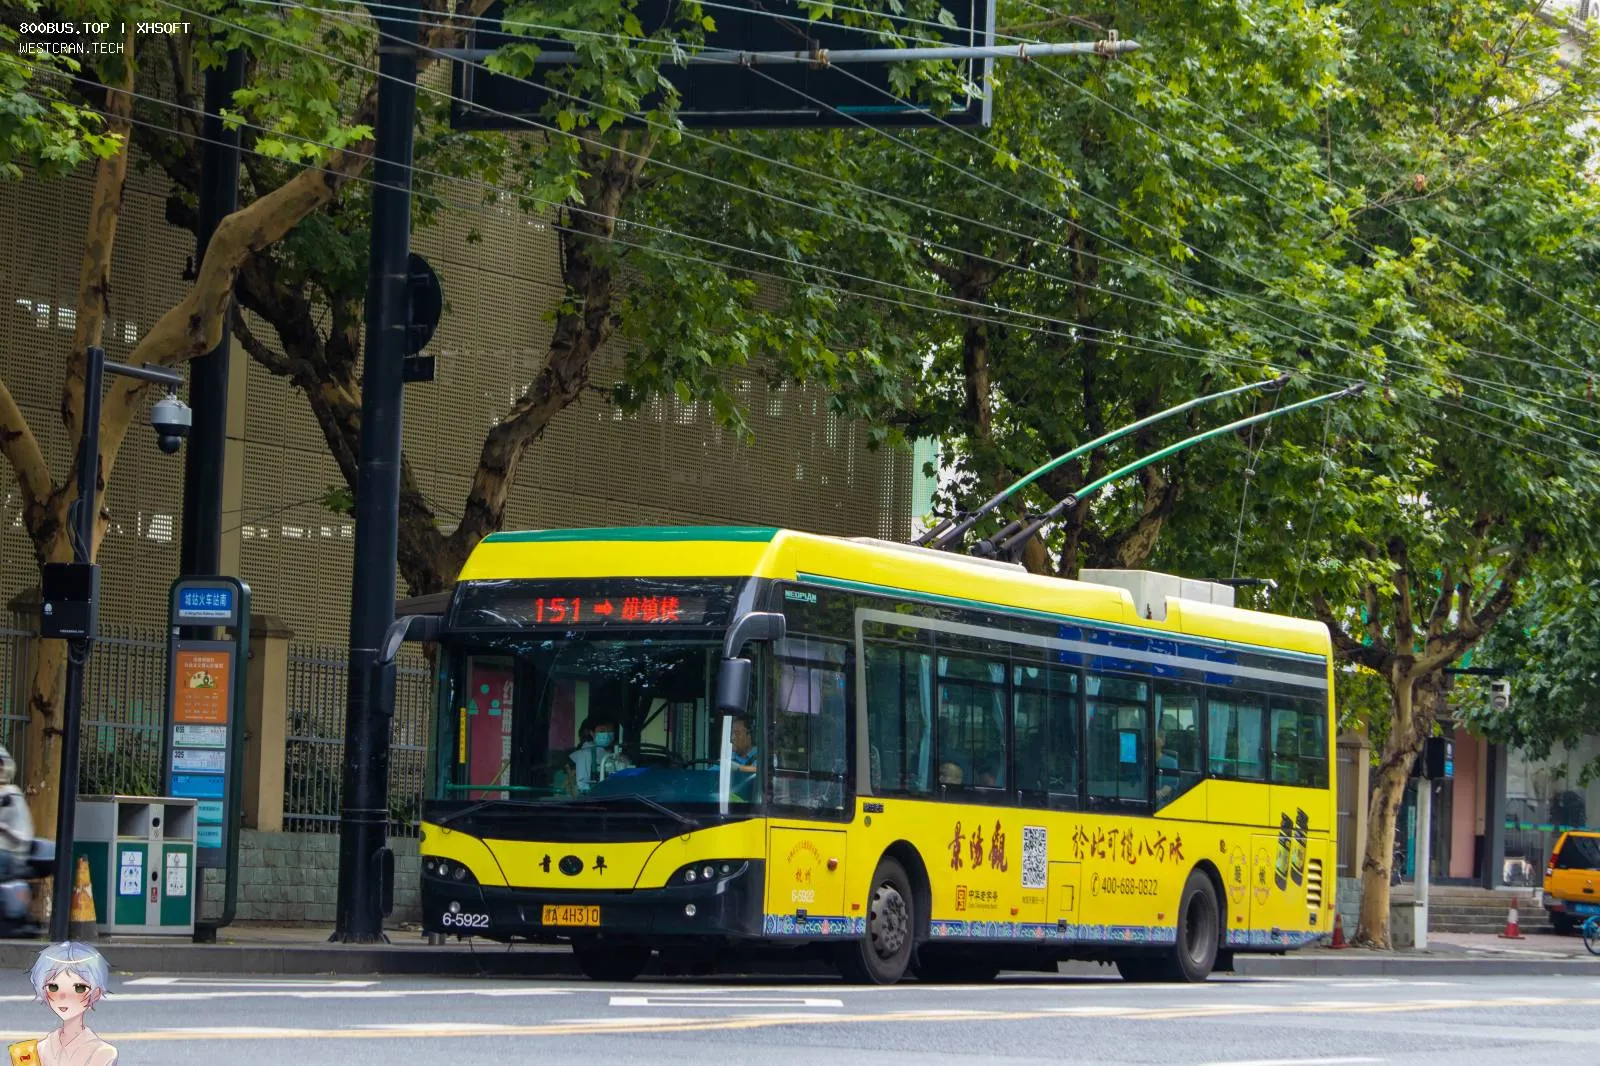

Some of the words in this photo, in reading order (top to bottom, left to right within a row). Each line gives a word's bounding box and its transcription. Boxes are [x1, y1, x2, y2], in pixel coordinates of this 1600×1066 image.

[784, 589, 817, 604] NEOPLAN
[535, 597, 581, 623] 151
[1102, 877, 1159, 896] 400-688-0822
[442, 912, 490, 929] 6-5922
